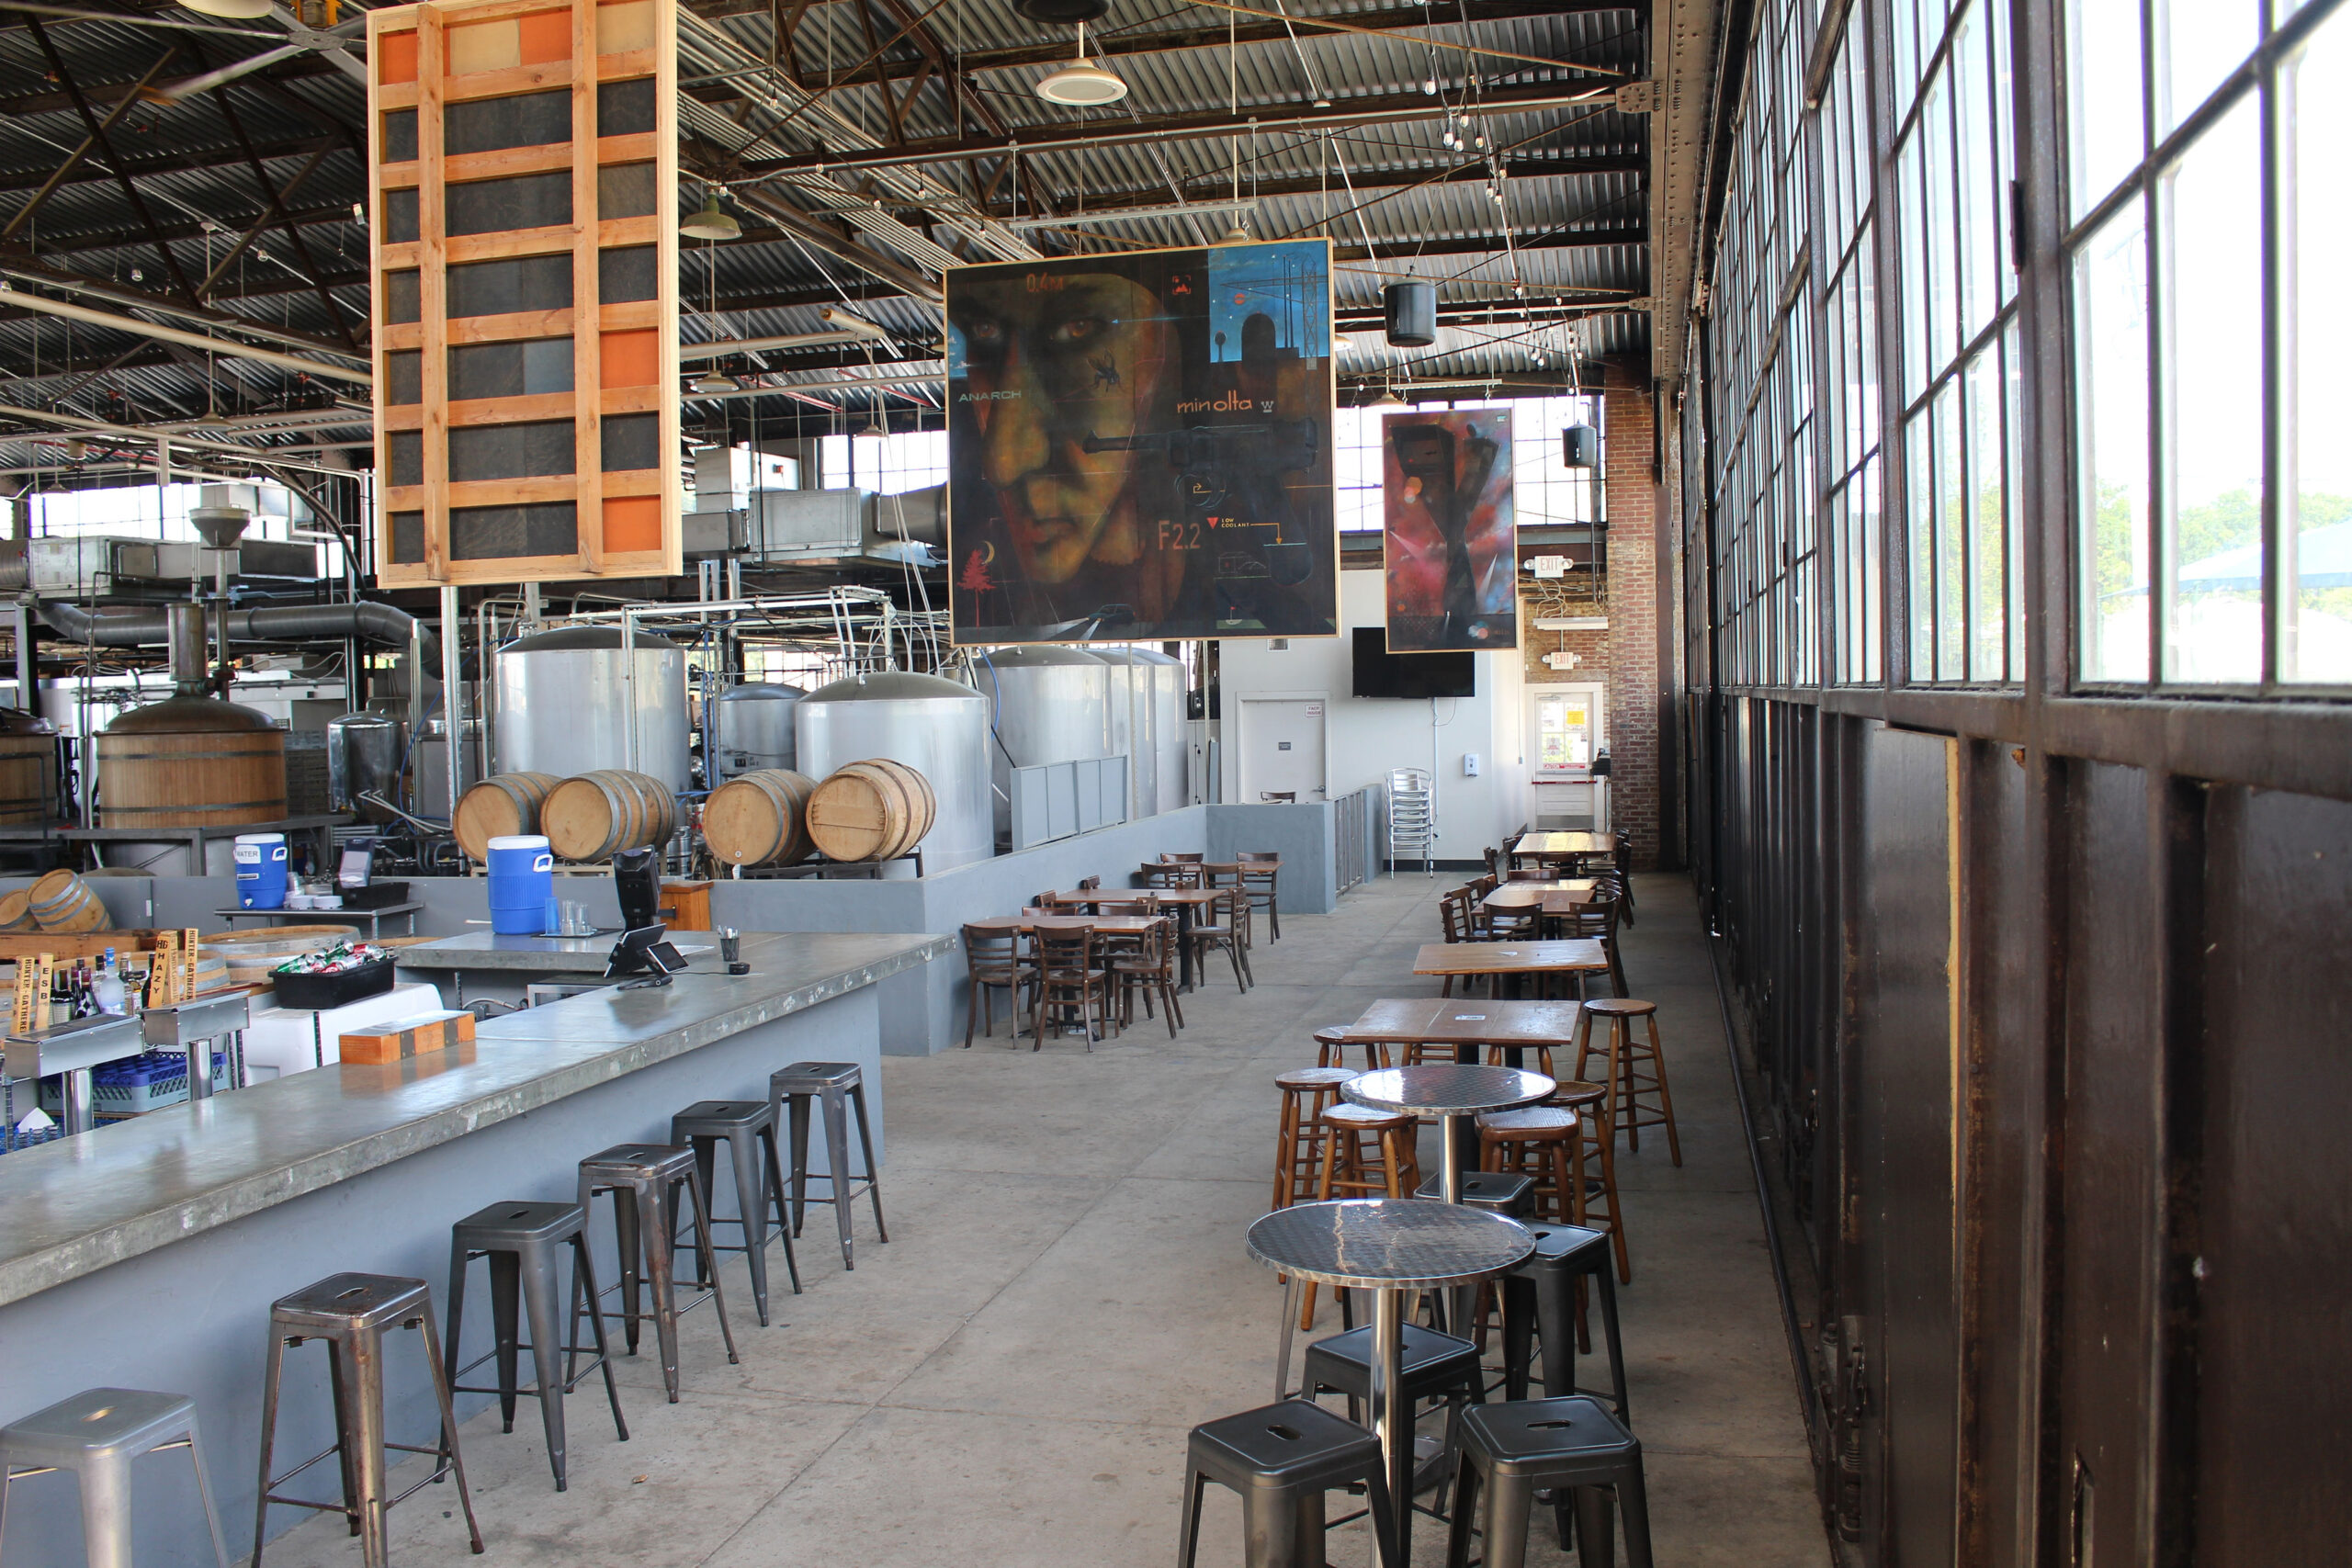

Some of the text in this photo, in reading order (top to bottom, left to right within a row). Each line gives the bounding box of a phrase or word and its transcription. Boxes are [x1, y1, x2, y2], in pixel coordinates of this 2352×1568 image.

[958, 390, 1022, 402] ANARCH
[1177, 389, 1252, 413] minolta
[1159, 520, 1201, 550] F2.2
[1540, 557, 1558, 570] EXIT
[1555, 653, 1569, 664] EXIT
[40, 967, 50, 999] ESB
[153, 953, 165, 994] HAZY
